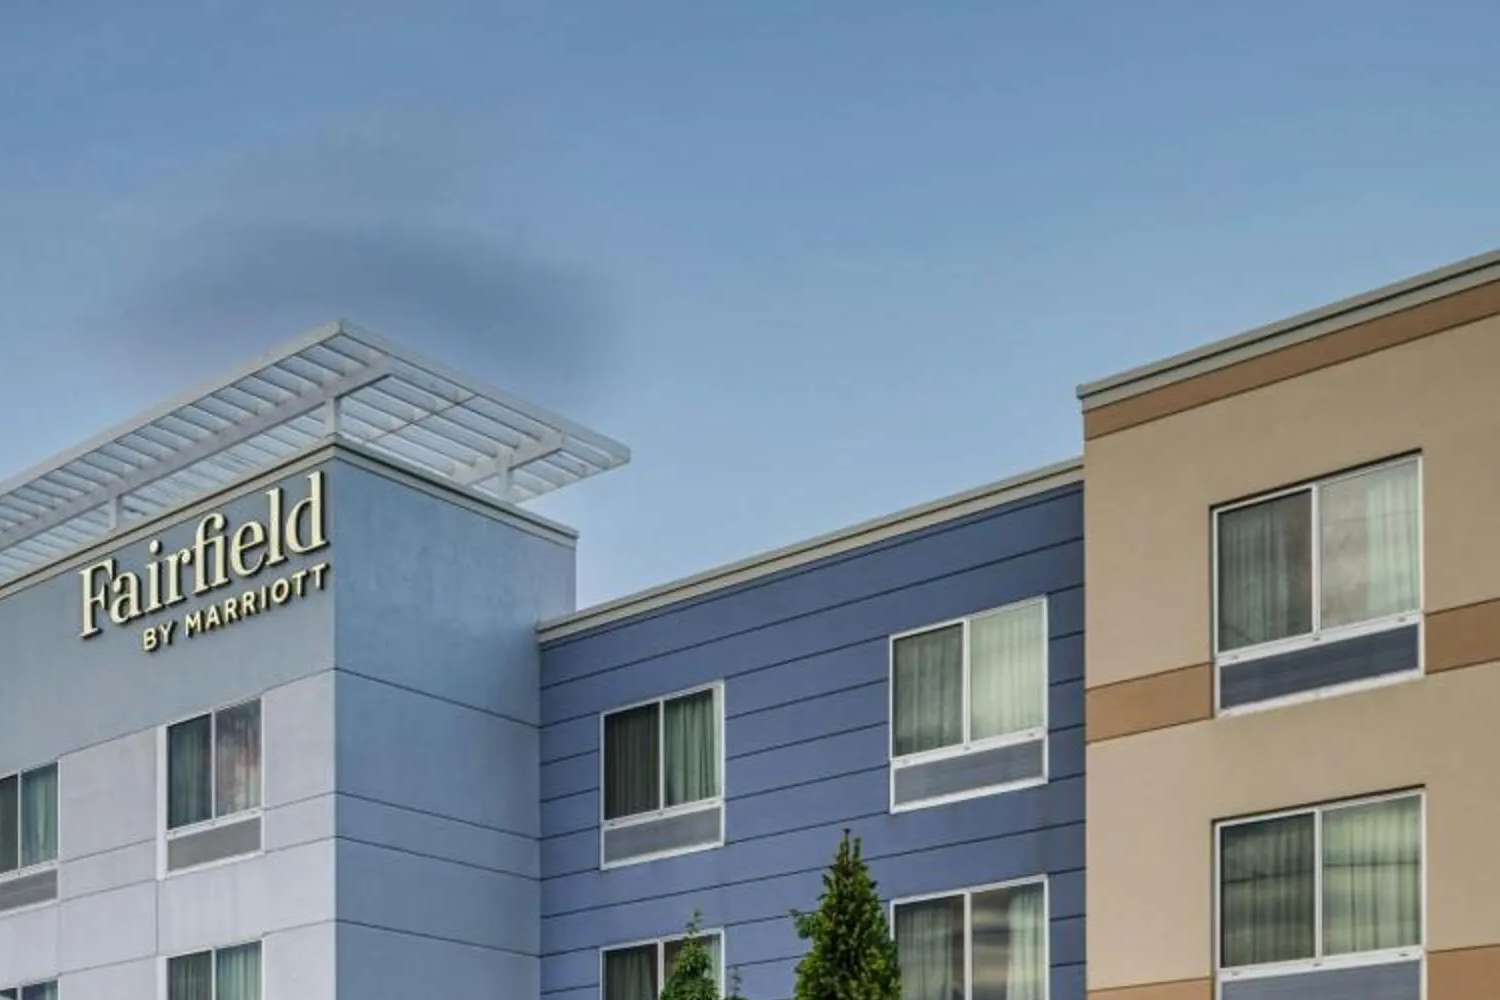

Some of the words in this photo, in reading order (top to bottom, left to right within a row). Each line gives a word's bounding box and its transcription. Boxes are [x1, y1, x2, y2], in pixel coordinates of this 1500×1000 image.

[79, 470, 328, 638] Fairfield
[143, 620, 175, 652] BY
[185, 563, 329, 637] MARRIOTT
